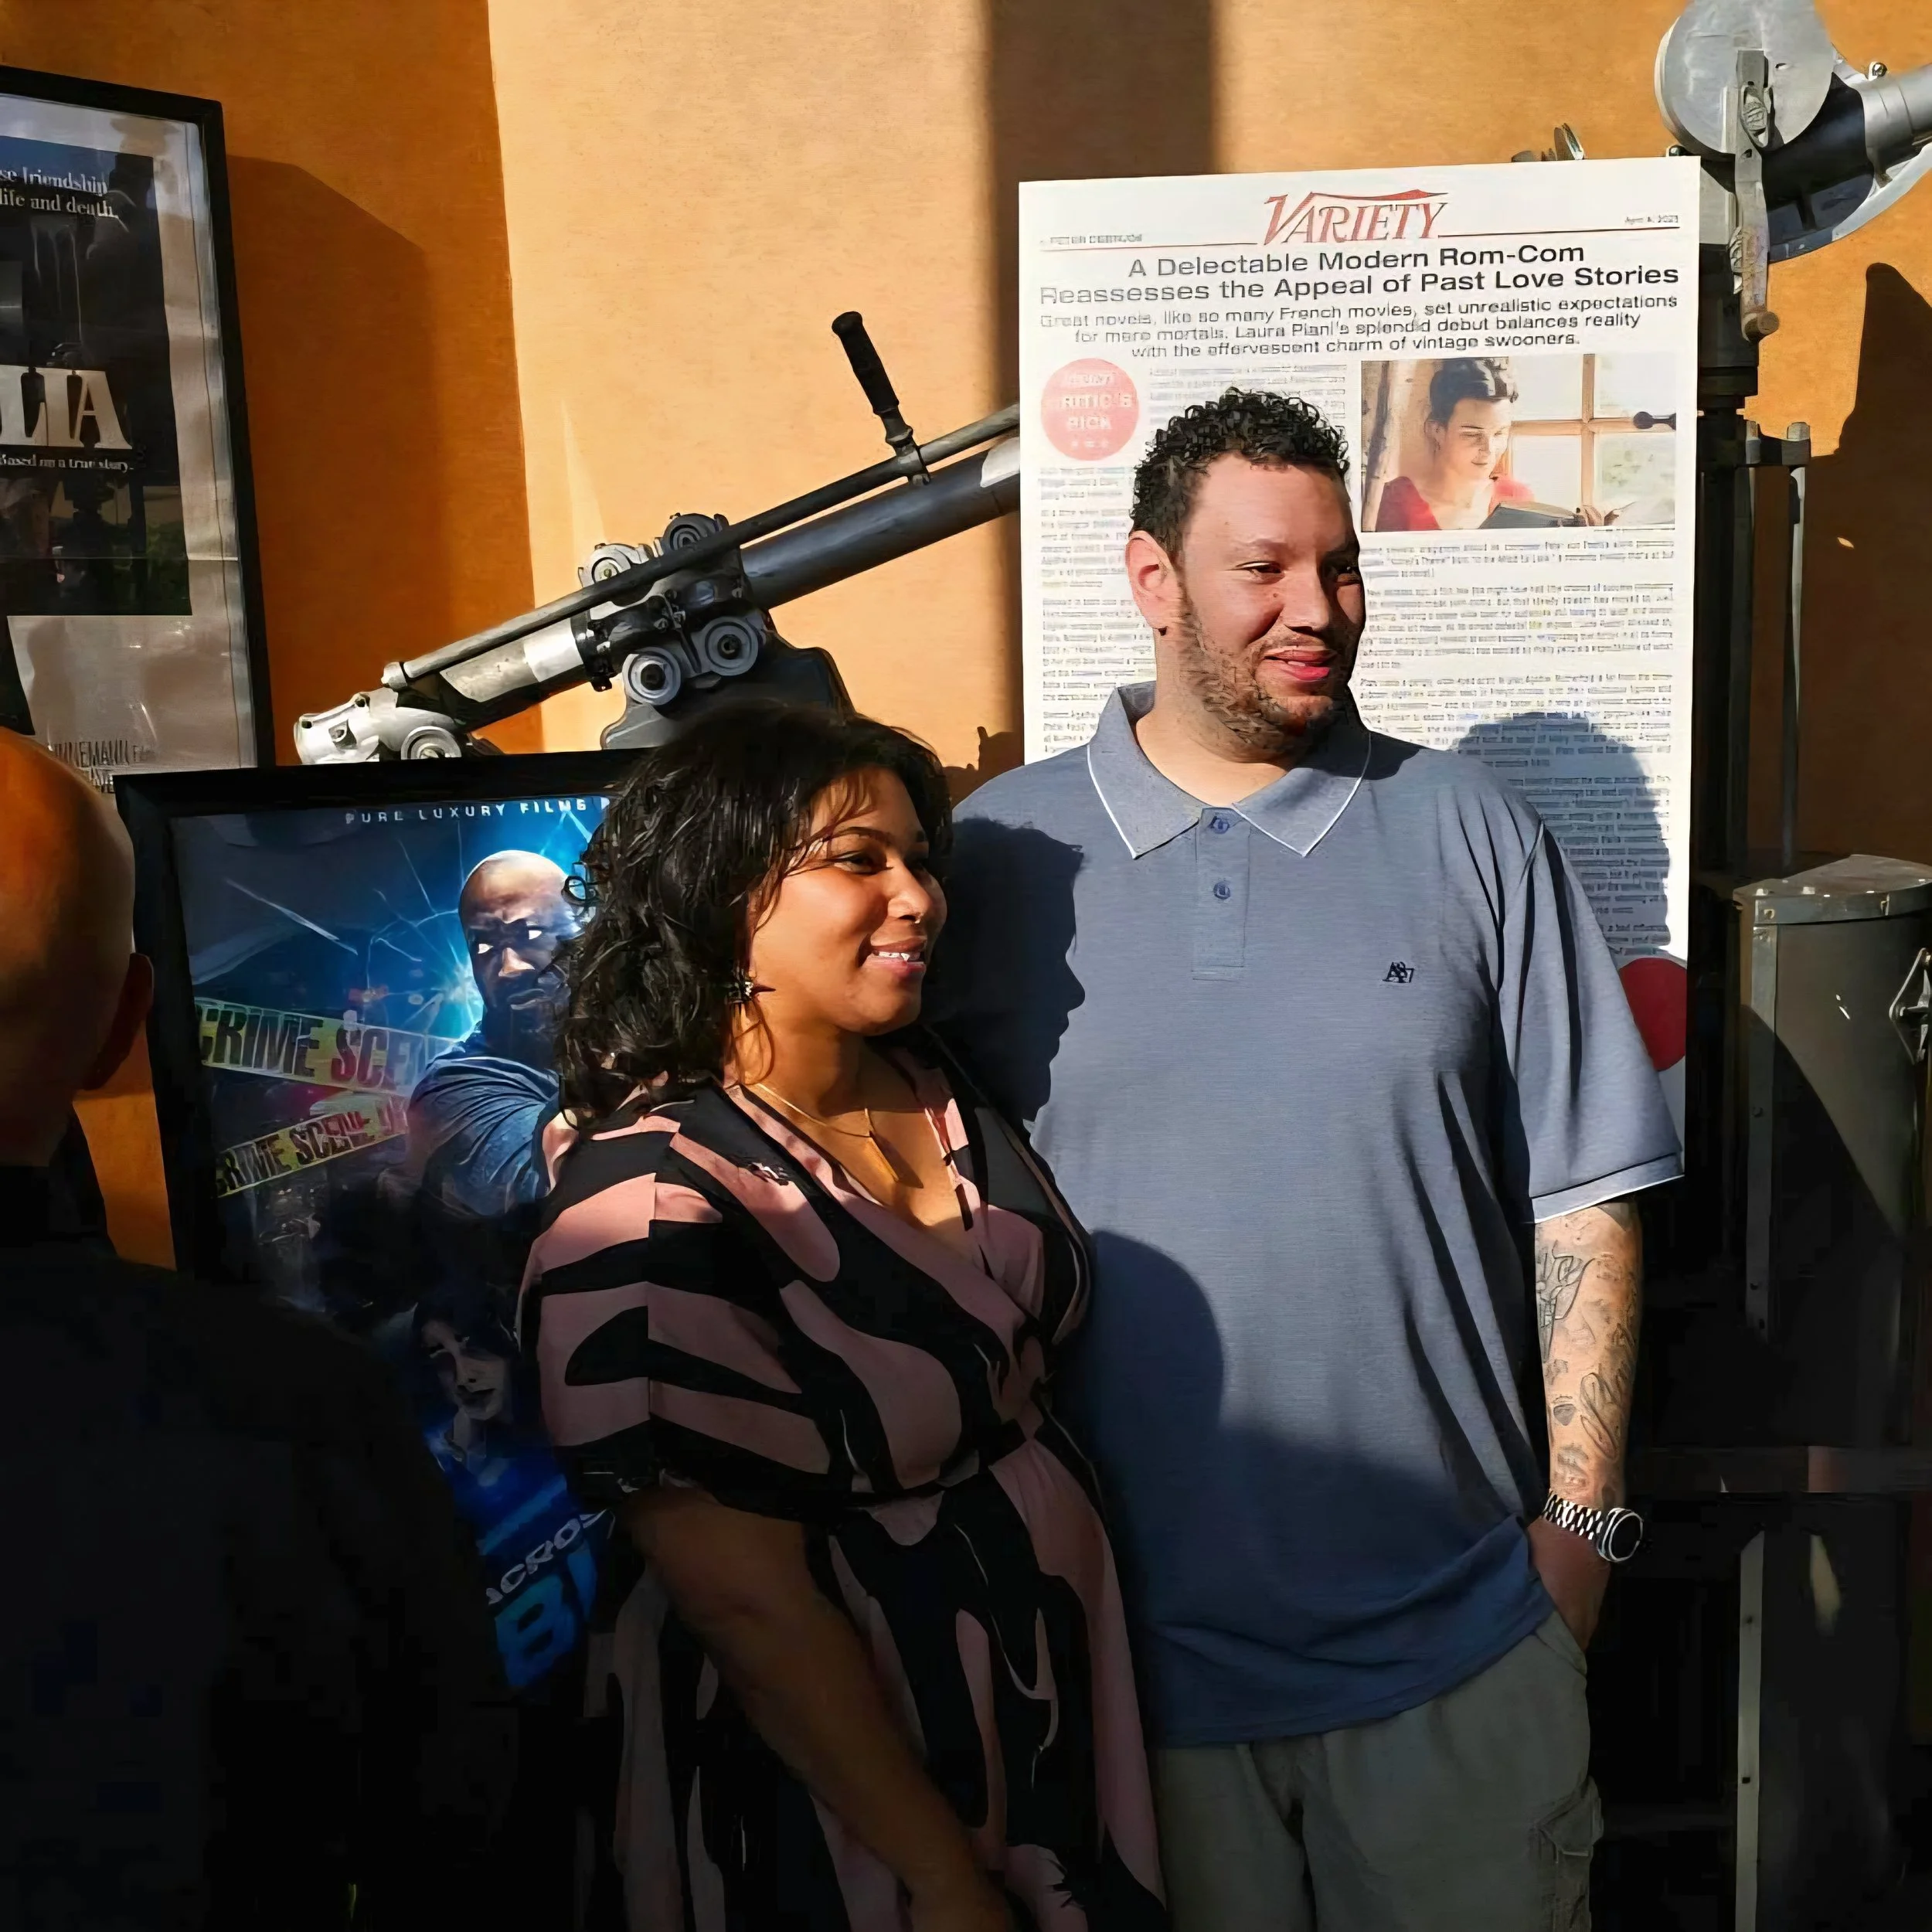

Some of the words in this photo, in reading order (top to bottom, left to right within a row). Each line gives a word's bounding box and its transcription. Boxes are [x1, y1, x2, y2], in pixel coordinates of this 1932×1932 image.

[31, 194, 61, 211] and
[1264, 189, 1448, 246] VARIETY
[1128, 259, 1147, 277] A
[1158, 253, 1308, 276] Delectable
[1320, 250, 1428, 271] Modern
[1440, 244, 1584, 266] Rom-Com
[1041, 283, 1209, 304] Reassesses
[1219, 281, 1264, 298] the
[1274, 276, 1372, 301] Appeal
[1383, 274, 1411, 293] of
[1421, 272, 1485, 292] Past
[1495, 270, 1564, 289] Love
[1574, 265, 1679, 286] Stories
[1164, 310, 1192, 325] like
[1199, 311, 1219, 323] so
[1226, 311, 1274, 325] many
[1280, 306, 1342, 320] French
[1349, 301, 1417, 319] movies,
[1424, 302, 1451, 316] set
[1458, 298, 1552, 315] unrealistic
[1558, 295, 1678, 313] expectations
[1075, 329, 1098, 342] for
[1236, 326, 1285, 338] Laura
[1438, 317, 1489, 332] debut
[1496, 315, 1579, 331] balances
[1585, 313, 1641, 328] reality
[1131, 345, 1167, 358] with
[1174, 343, 1201, 357] the
[1207, 342, 1319, 355] effervescent
[1326, 338, 1383, 352] charm
[1390, 336, 1406, 350] of
[1413, 336, 1478, 351] vintage
[345, 811, 403, 825] PURE
[419, 804, 505, 821] LUXURY
[520, 798, 587, 814] FILMS
